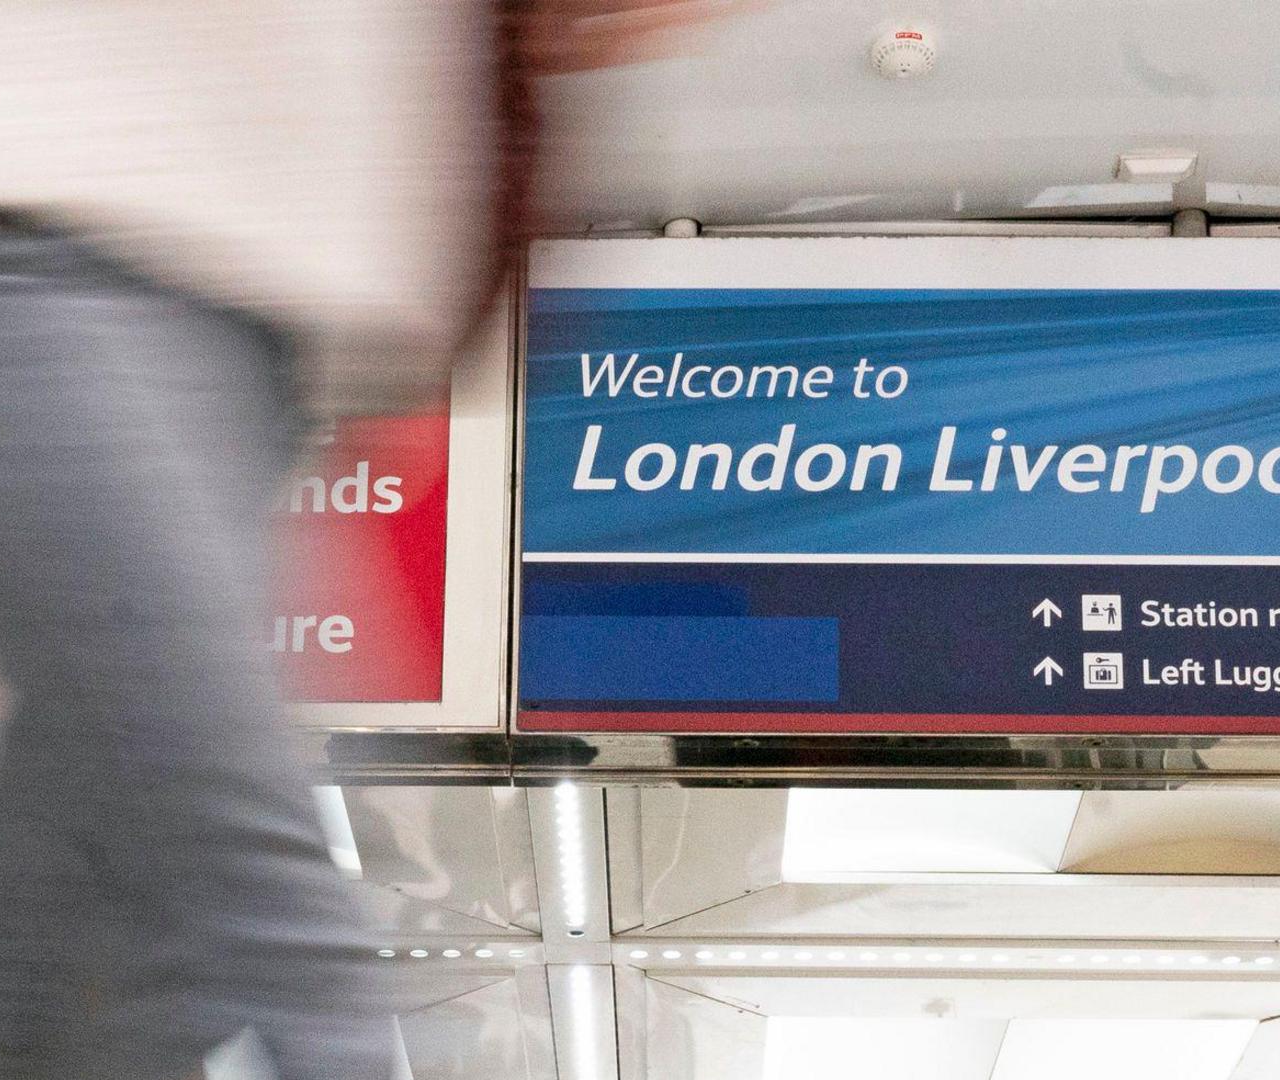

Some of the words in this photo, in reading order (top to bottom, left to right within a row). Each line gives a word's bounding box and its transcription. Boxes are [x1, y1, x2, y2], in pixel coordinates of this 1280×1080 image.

[579, 353, 834, 399] Welcome
[852, 357, 909, 399] to
[572, 423, 904, 492] London
[1140, 600, 1258, 629] Station
[1142, 659, 1205, 687] Left
